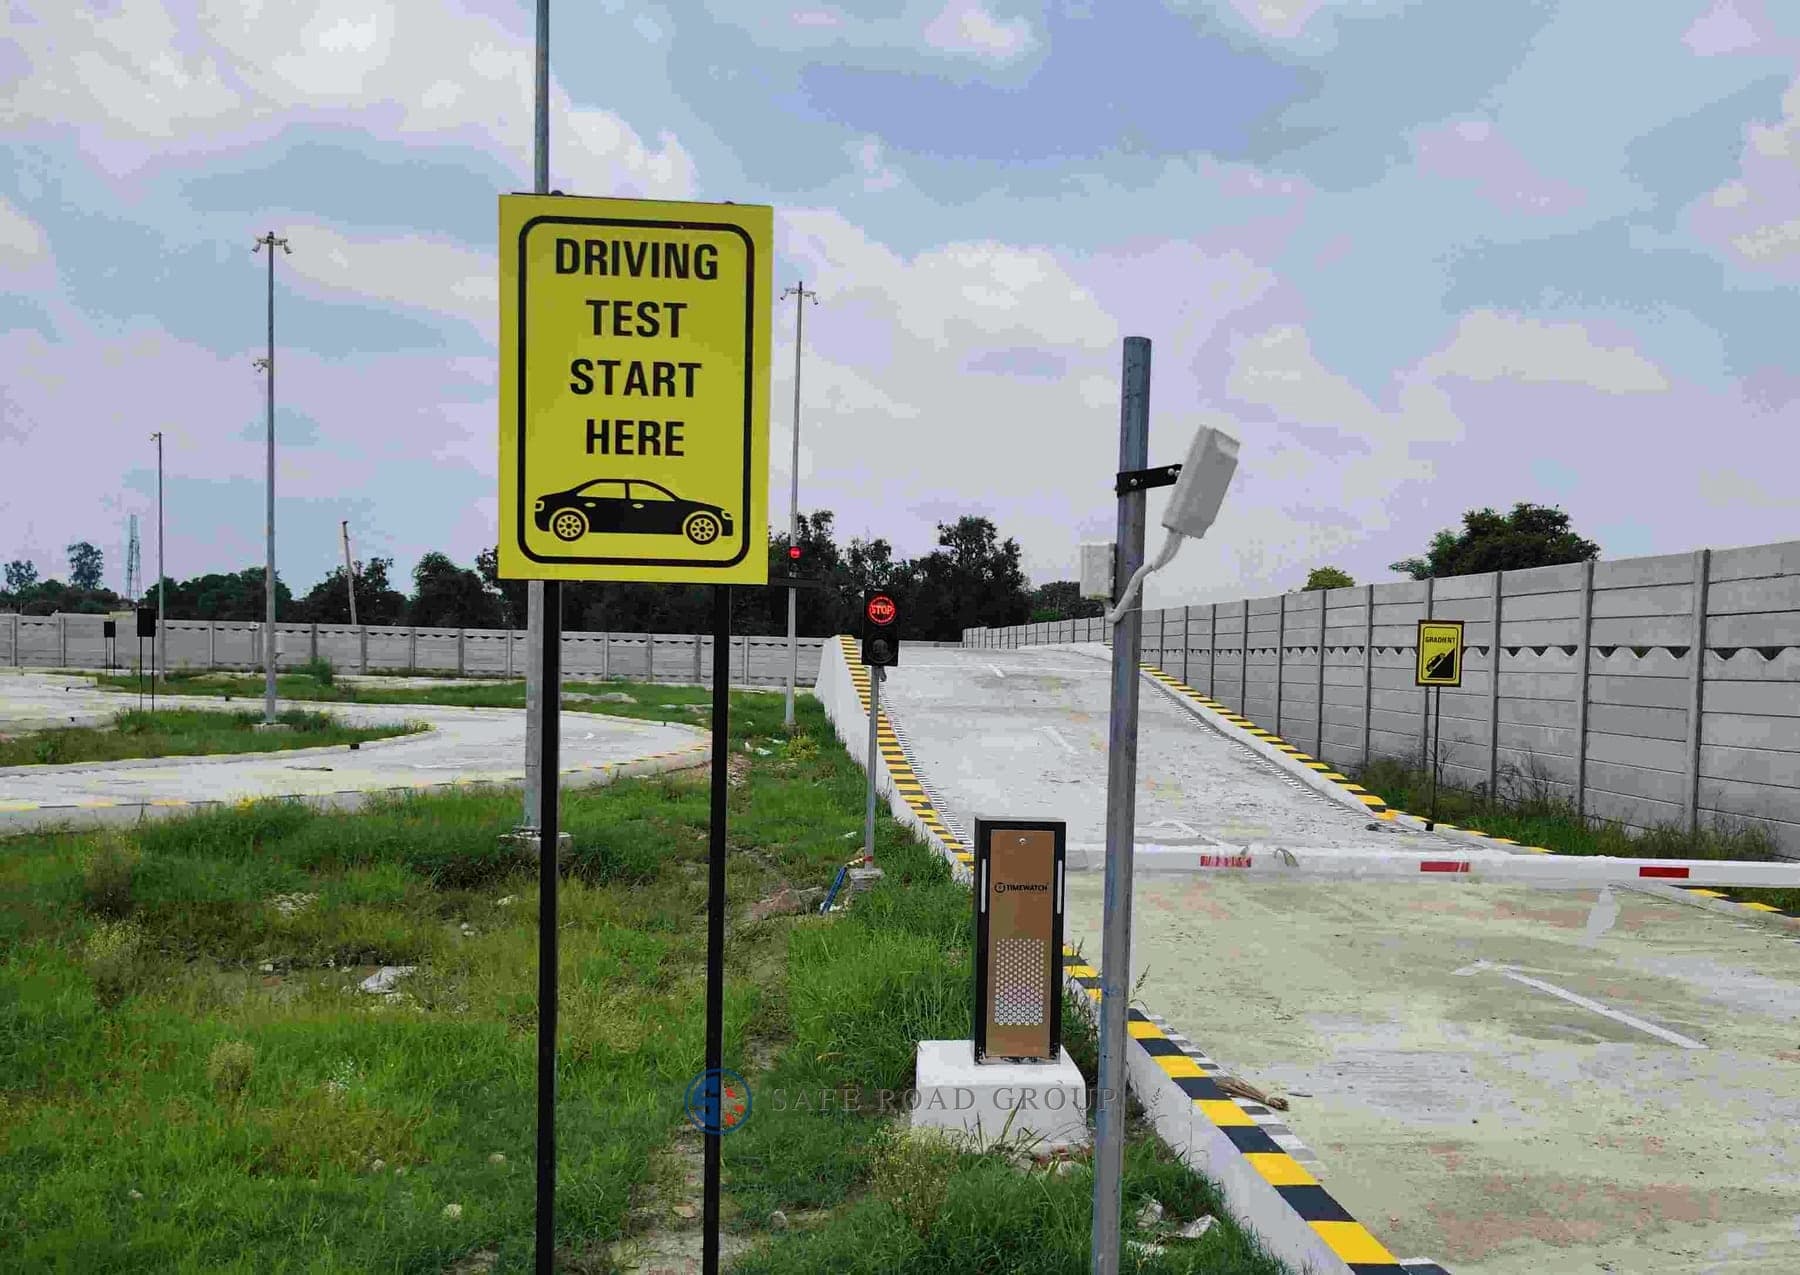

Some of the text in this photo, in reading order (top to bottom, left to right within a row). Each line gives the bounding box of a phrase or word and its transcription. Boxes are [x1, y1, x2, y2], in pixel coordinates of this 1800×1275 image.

[555, 238, 718, 280] DRIVING
[585, 299, 688, 338] TEST
[570, 358, 702, 398] START
[586, 418, 685, 457] HERE
[871, 604, 893, 615] STOP
